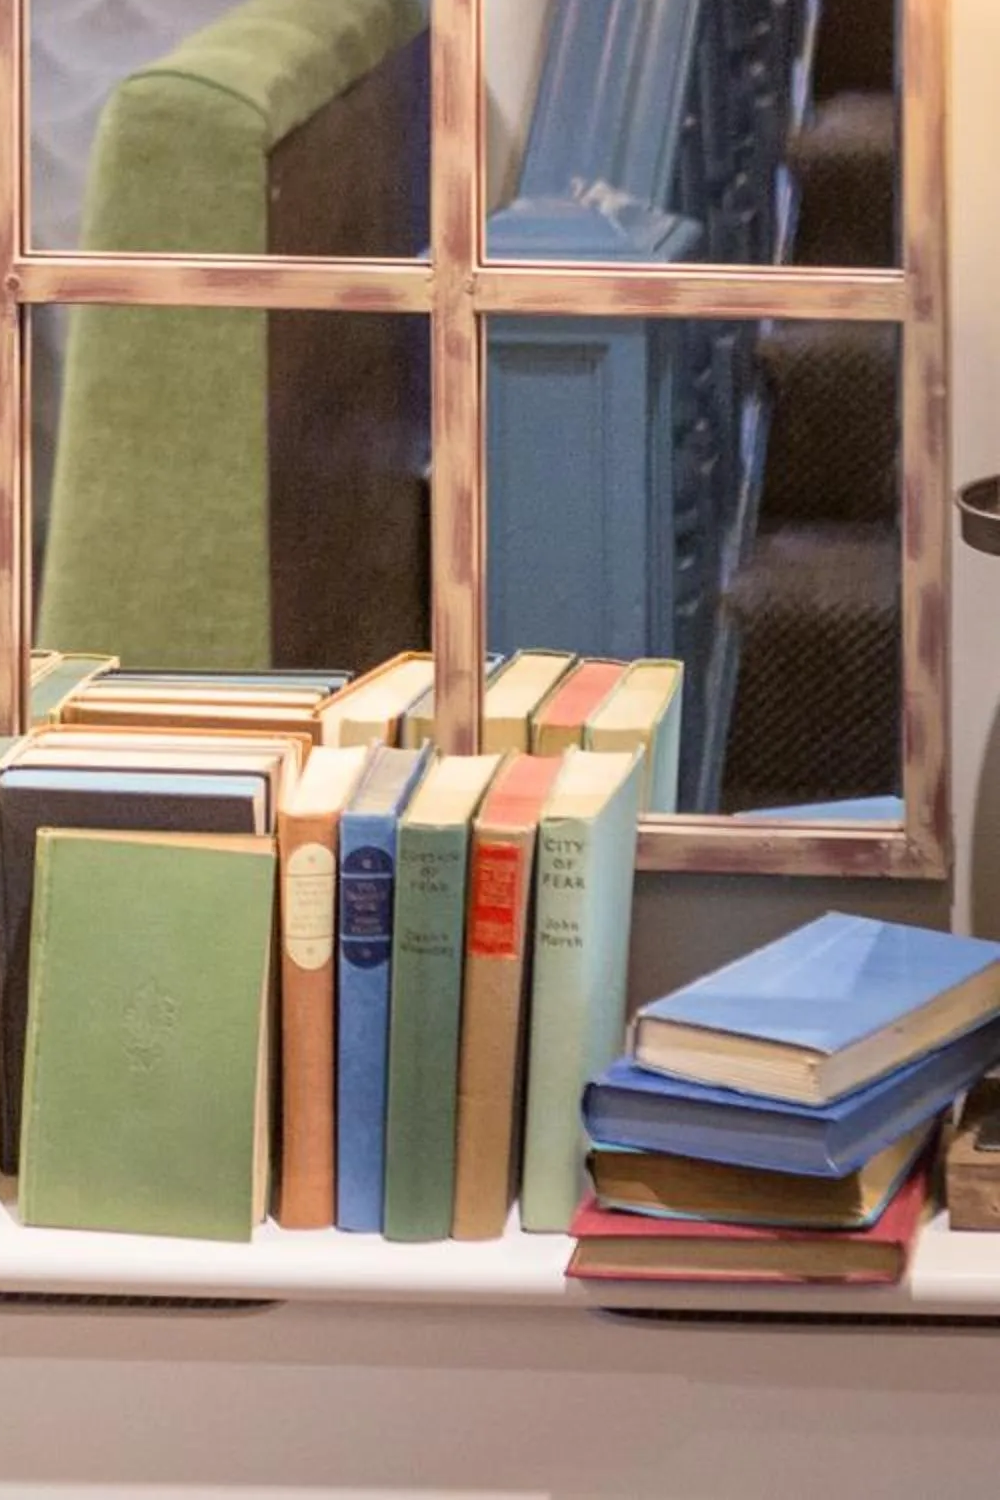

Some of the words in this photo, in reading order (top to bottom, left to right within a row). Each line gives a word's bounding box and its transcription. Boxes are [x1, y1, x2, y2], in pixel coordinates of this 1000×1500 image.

[543, 837, 584, 852] CITY
[552, 857, 574, 870] OF
[542, 872, 585, 889] FEAR
[545, 915, 580, 932] John
[539, 931, 583, 948] Marsh
